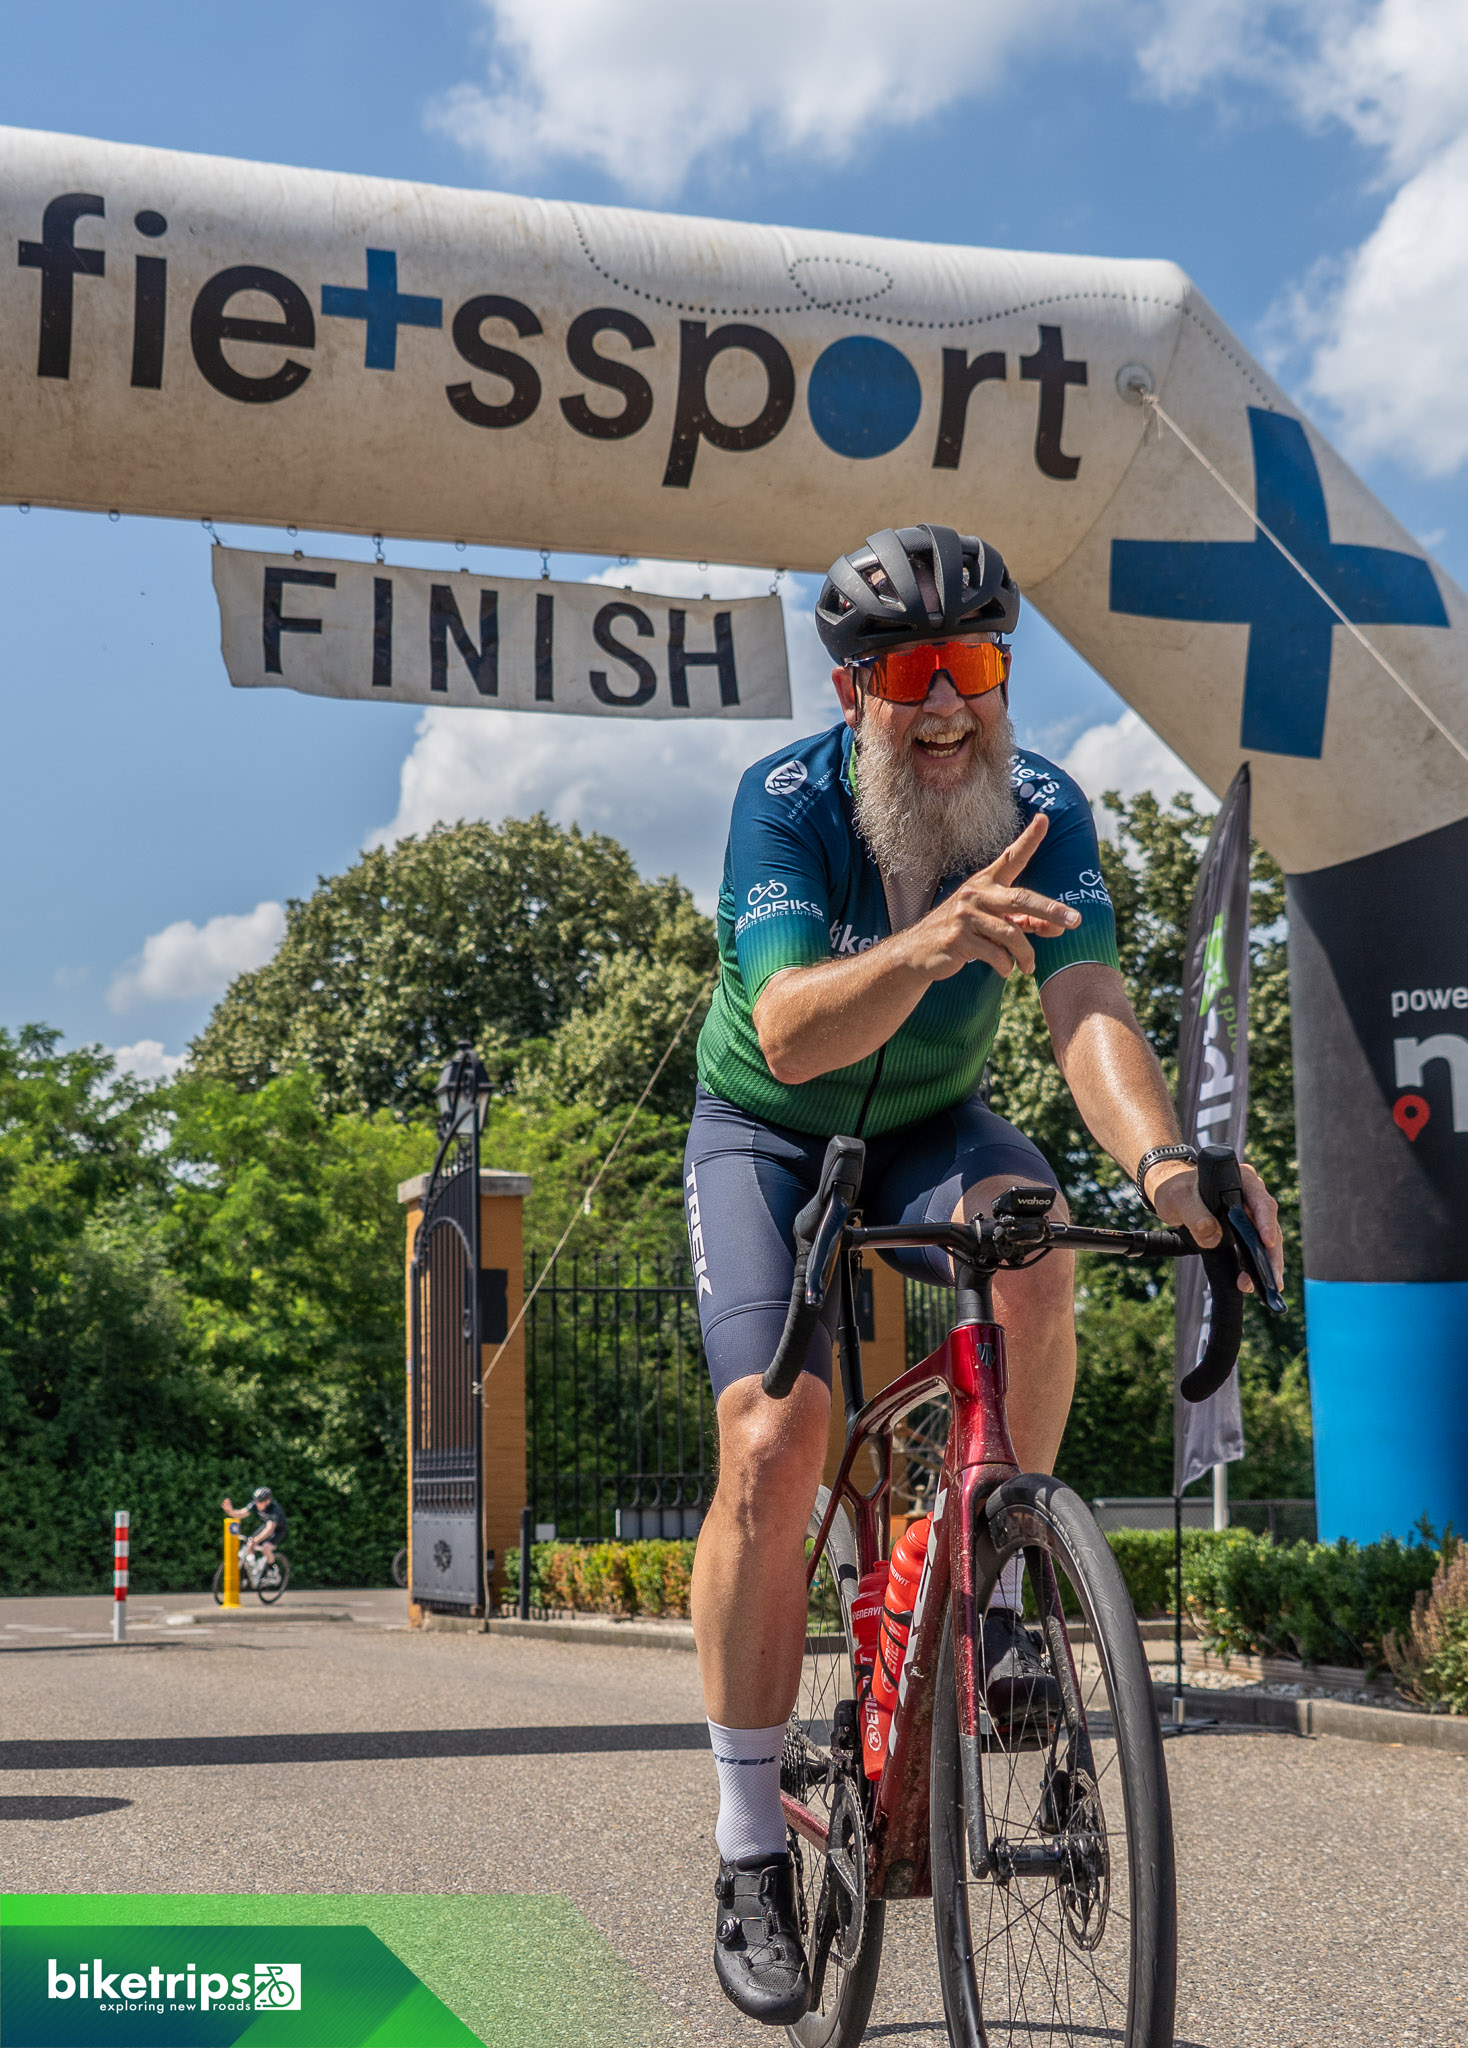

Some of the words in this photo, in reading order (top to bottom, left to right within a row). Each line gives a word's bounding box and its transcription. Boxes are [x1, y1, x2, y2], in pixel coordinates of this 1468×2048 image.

[263, 566, 740, 708] FINISH
[1008, 776, 1057, 813] port
[1056, 889, 1112, 906] HEND
[1018, 1196, 1051, 1206] wahoo
[686, 1161, 713, 1303] TREK
[715, 1754, 776, 1766] TREK
